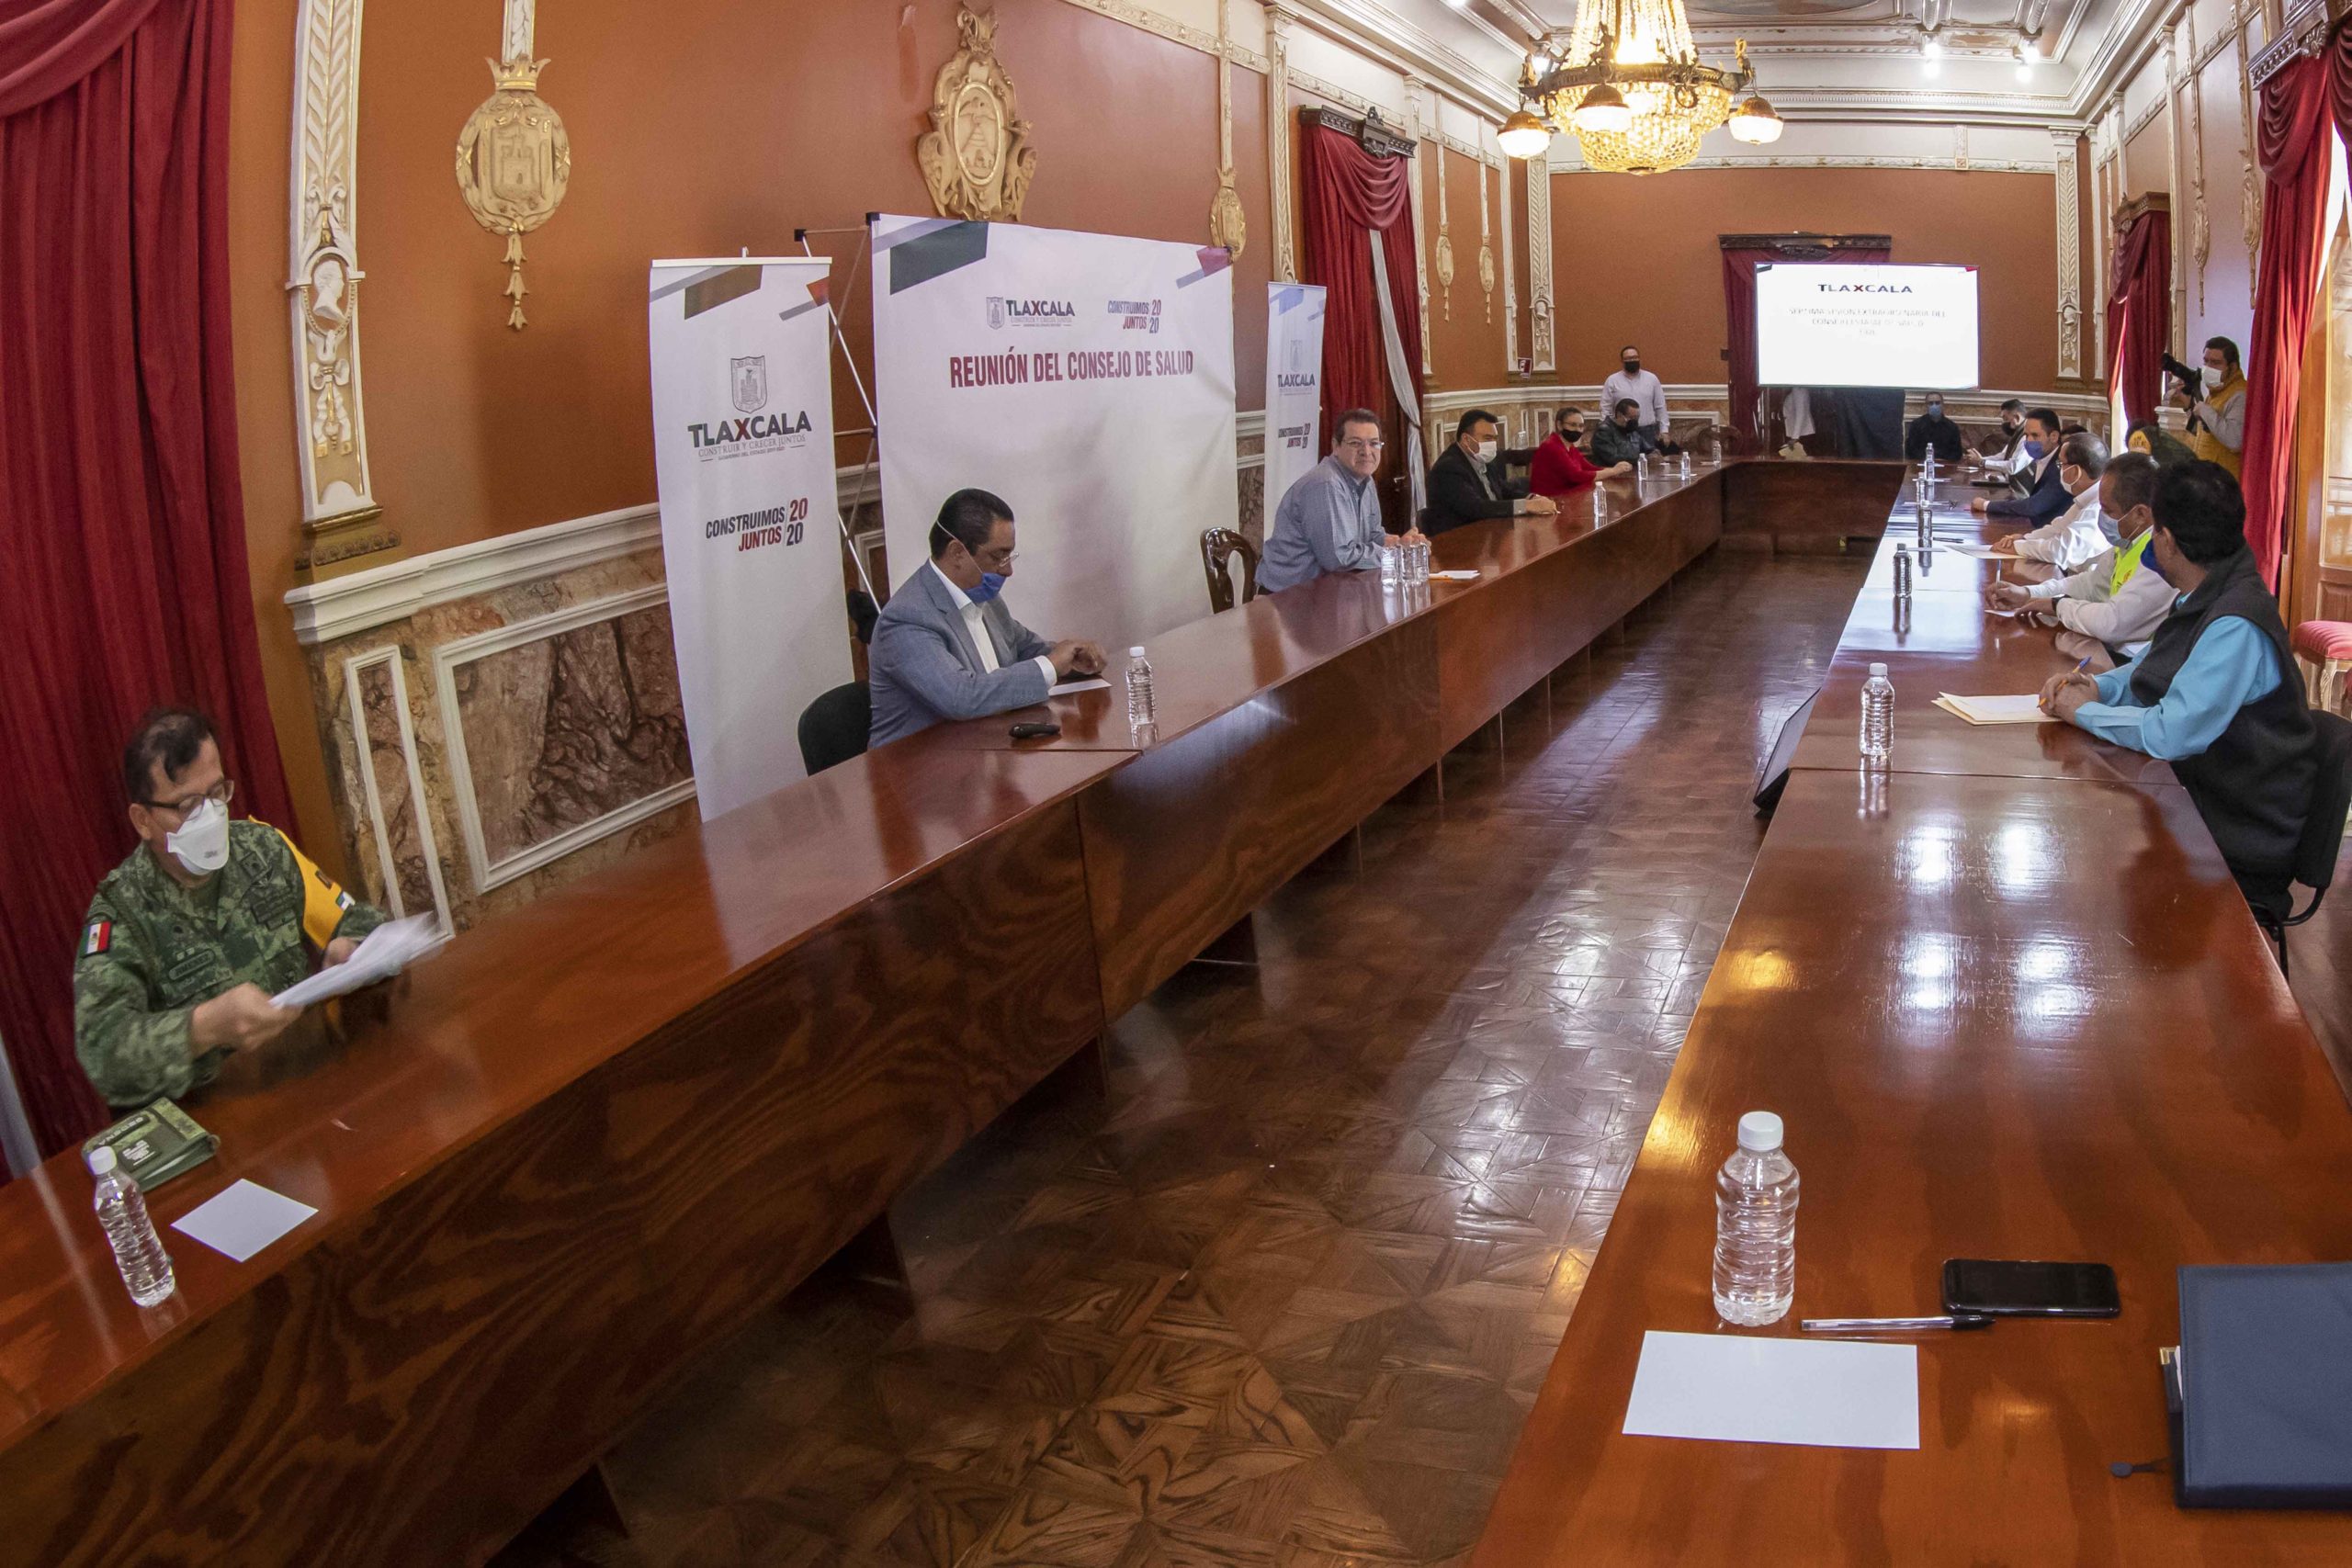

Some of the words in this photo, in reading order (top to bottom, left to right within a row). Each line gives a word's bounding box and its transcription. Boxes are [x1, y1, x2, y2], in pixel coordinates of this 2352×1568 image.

[1818, 284, 1913, 293] TLAXCALA
[1006, 299, 1075, 316] TLAXCALA
[1107, 300, 1149, 314] CONSTRUIMOS
[1151, 299, 1161, 316] 20
[1123, 316, 1147, 330] JUNTOS
[1149, 317, 1159, 333] 20
[950, 346, 1028, 388] REUNIÓN
[1034, 353, 1063, 382] DEL
[1068, 351, 1131, 380] CONSEJO
[1136, 351, 1152, 376] DE
[1156, 350, 1193, 376] SALUD
[1278, 374, 1315, 387] TLAXCALA
[687, 411, 812, 447] TLAXCALA
[698, 443, 740, 457] CONSTRUIR
[778, 434, 806, 447] JUNTOS
[789, 498, 808, 523] 20
[706, 506, 786, 539] CONSTRUIMOS
[739, 525, 782, 551] JUNTOS
[786, 522, 803, 547] 20
